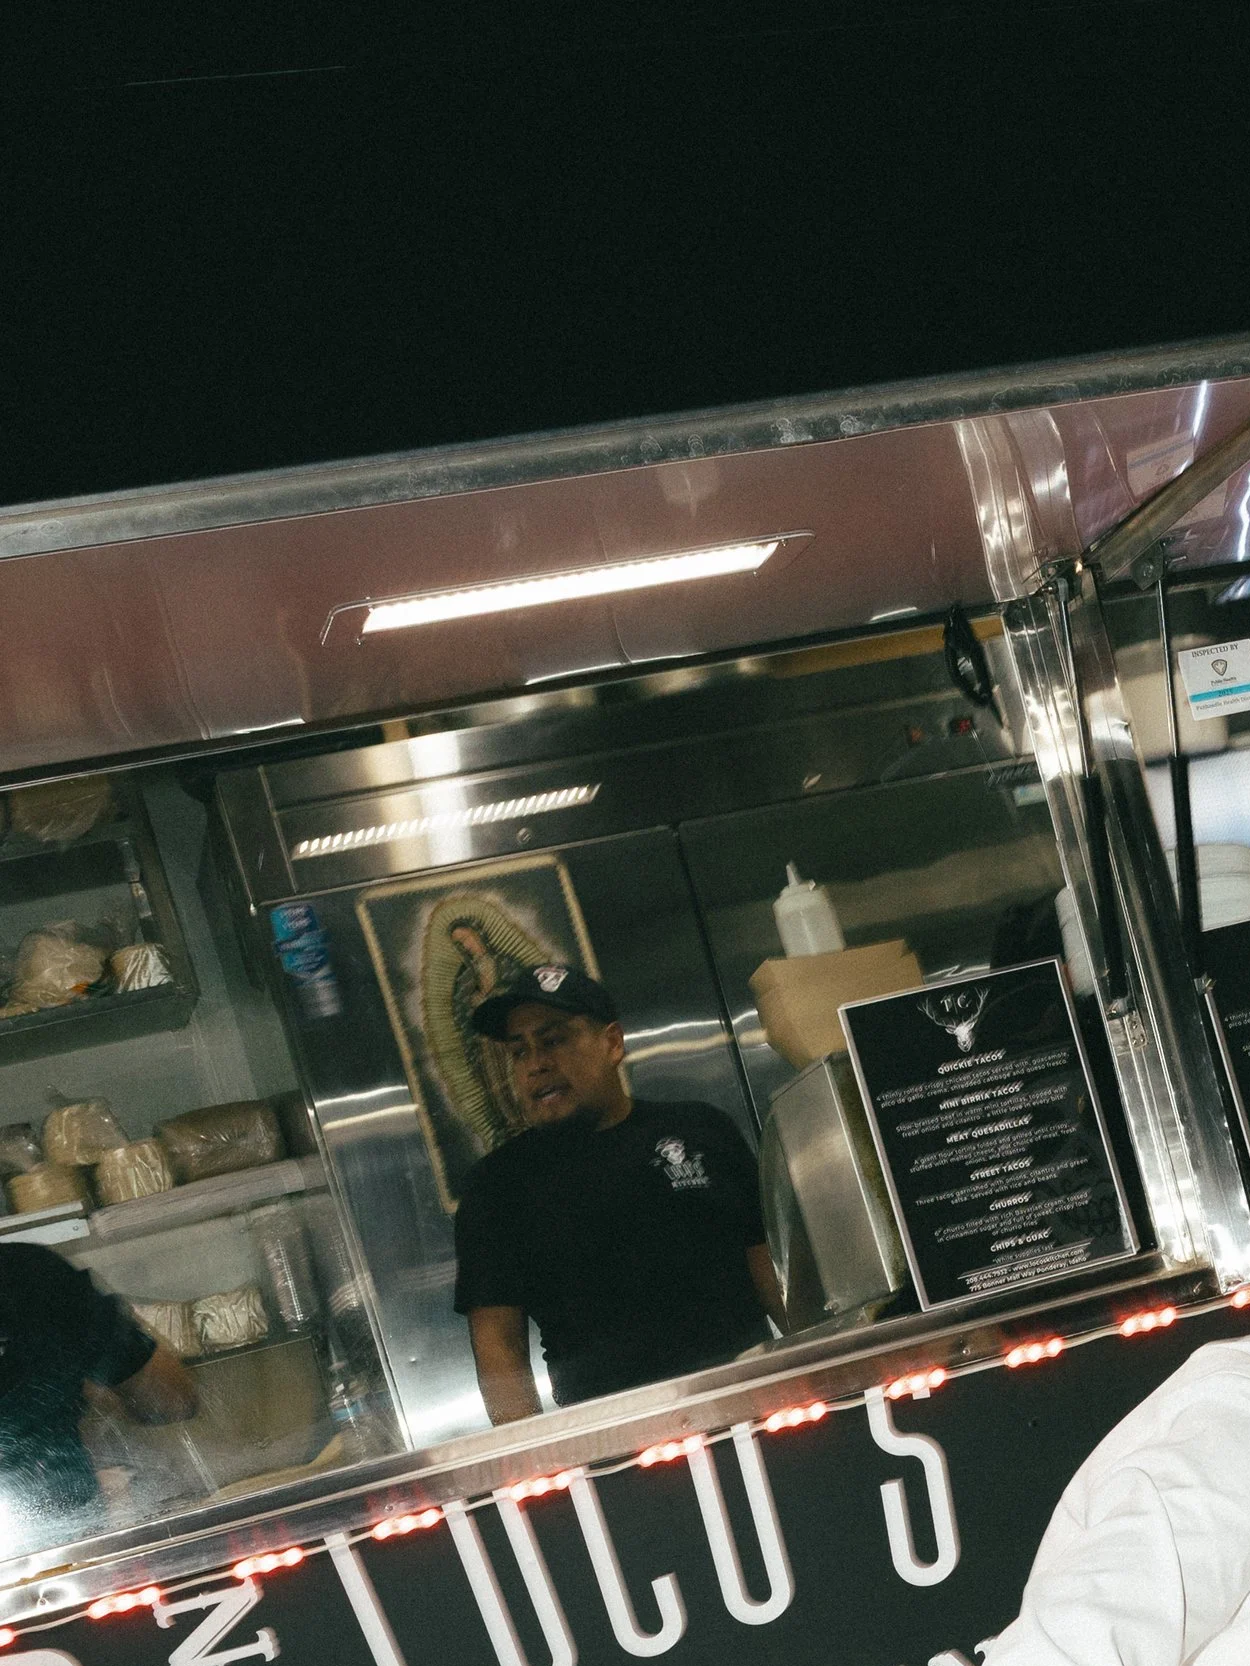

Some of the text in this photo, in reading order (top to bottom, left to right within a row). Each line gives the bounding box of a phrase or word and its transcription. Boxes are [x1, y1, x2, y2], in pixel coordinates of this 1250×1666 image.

[1191, 643, 1239, 658] INSPECTED BY
[1223, 697, 1240, 705] Health
[936, 1052, 1003, 1075] QUICKIE TACOS
[938, 1084, 1020, 1111] MINI BIRRIA TACOS
[945, 1116, 1029, 1144] MEAT QUESADILLAS
[914, 1196, 935, 1207] Three
[935, 1191, 955, 1202] tacos
[954, 1182, 989, 1197] garnished
[989, 1178, 1004, 1188] with
[1028, 1165, 1055, 1178] cilantro
[1055, 1161, 1068, 1171] and
[1068, 1156, 1089, 1167] green
[968, 1159, 1030, 1181] STREET TACOS
[969, 1188, 993, 1200] Served
[993, 1184, 1008, 1193] with
[1008, 1181, 1022, 1190] rice
[1022, 1177, 1036, 1186] and
[988, 1194, 1029, 1211] CHURROS
[936, 1236, 944, 1244] in
[944, 1227, 978, 1242] cinnamon
[978, 1222, 998, 1232] sugar
[998, 1218, 1012, 1227] and
[1012, 1215, 1024, 1223] full
[1024, 1212, 1032, 1220] of
[1054, 1201, 1074, 1212] crispy
[1073, 1198, 1089, 1207] love
[999, 1222, 1023, 1234] churro
[1022, 1218, 1038, 1228] fries
[989, 1239, 1016, 1252] CHIPS
[1024, 1230, 1049, 1243] GUAC
[968, 1283, 982, 1293] 775
[981, 1277, 1006, 1289] Bonner
[1006, 1273, 1021, 1283] Mall
[1020, 1268, 1036, 1279] Way
[1068, 1254, 1087, 1266] Idaho
